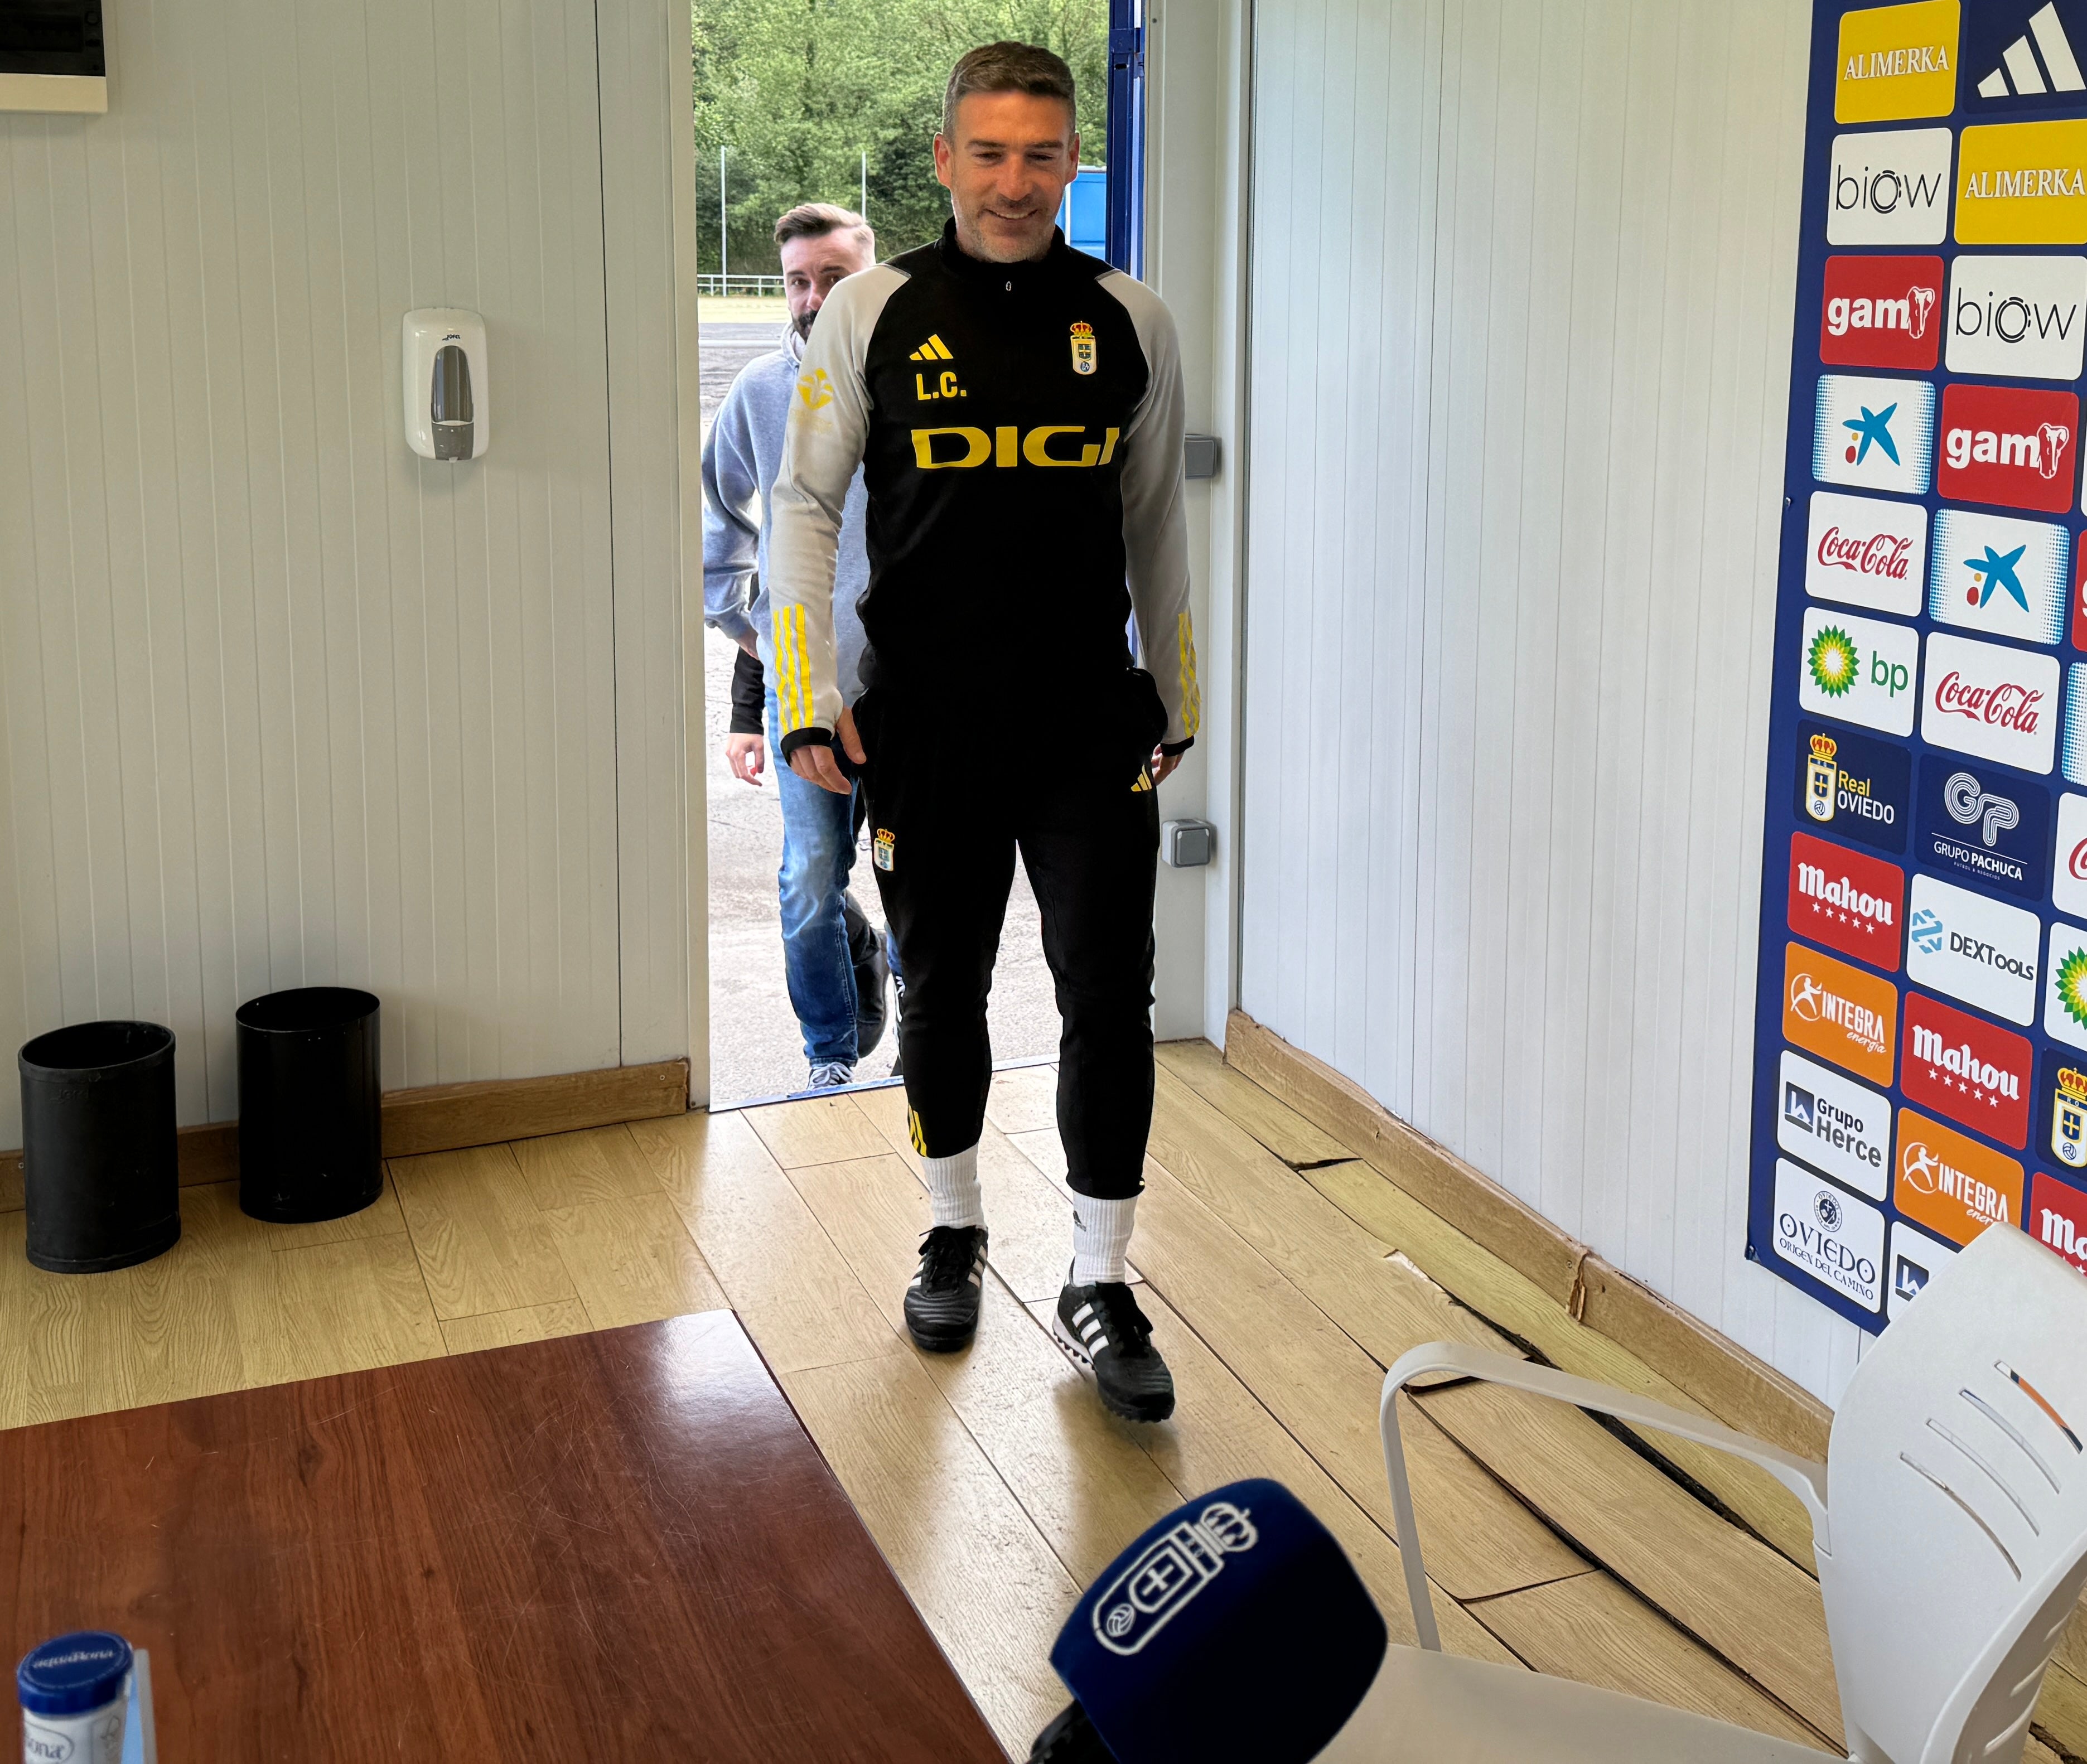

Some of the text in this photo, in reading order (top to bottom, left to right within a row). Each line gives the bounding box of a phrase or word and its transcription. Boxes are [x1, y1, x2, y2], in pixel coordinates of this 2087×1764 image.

[1843, 45, 1949, 80] ALIMERKA
[1964, 168, 2086, 199] ALIMERKA
[1828, 297, 1910, 336] gam
[916, 371, 967, 400] L.C.
[911, 426, 1120, 468] DIGI
[1946, 428, 2041, 469] gam
[1818, 526, 1914, 580] Coca-Cola
[1871, 651, 1909, 698] bp
[1935, 671, 2045, 734] Coca-Cola
[1838, 770, 1871, 797] Real
[1837, 790, 1895, 824] OVIEDO
[1934, 841, 2023, 881] GRUPO PACHUCA
[1822, 990, 1885, 1044] INTEGRA
[1817, 1098, 1863, 1133] Grupo
[1817, 1119, 1881, 1168] Herce
[1938, 1162, 2008, 1222] INTEGRA
[1966, 1209, 1994, 1225] ener
[1780, 1213, 1875, 1284] OVIEDO
[1780, 1238, 1873, 1300] ORIGEN DEL CAMINO
